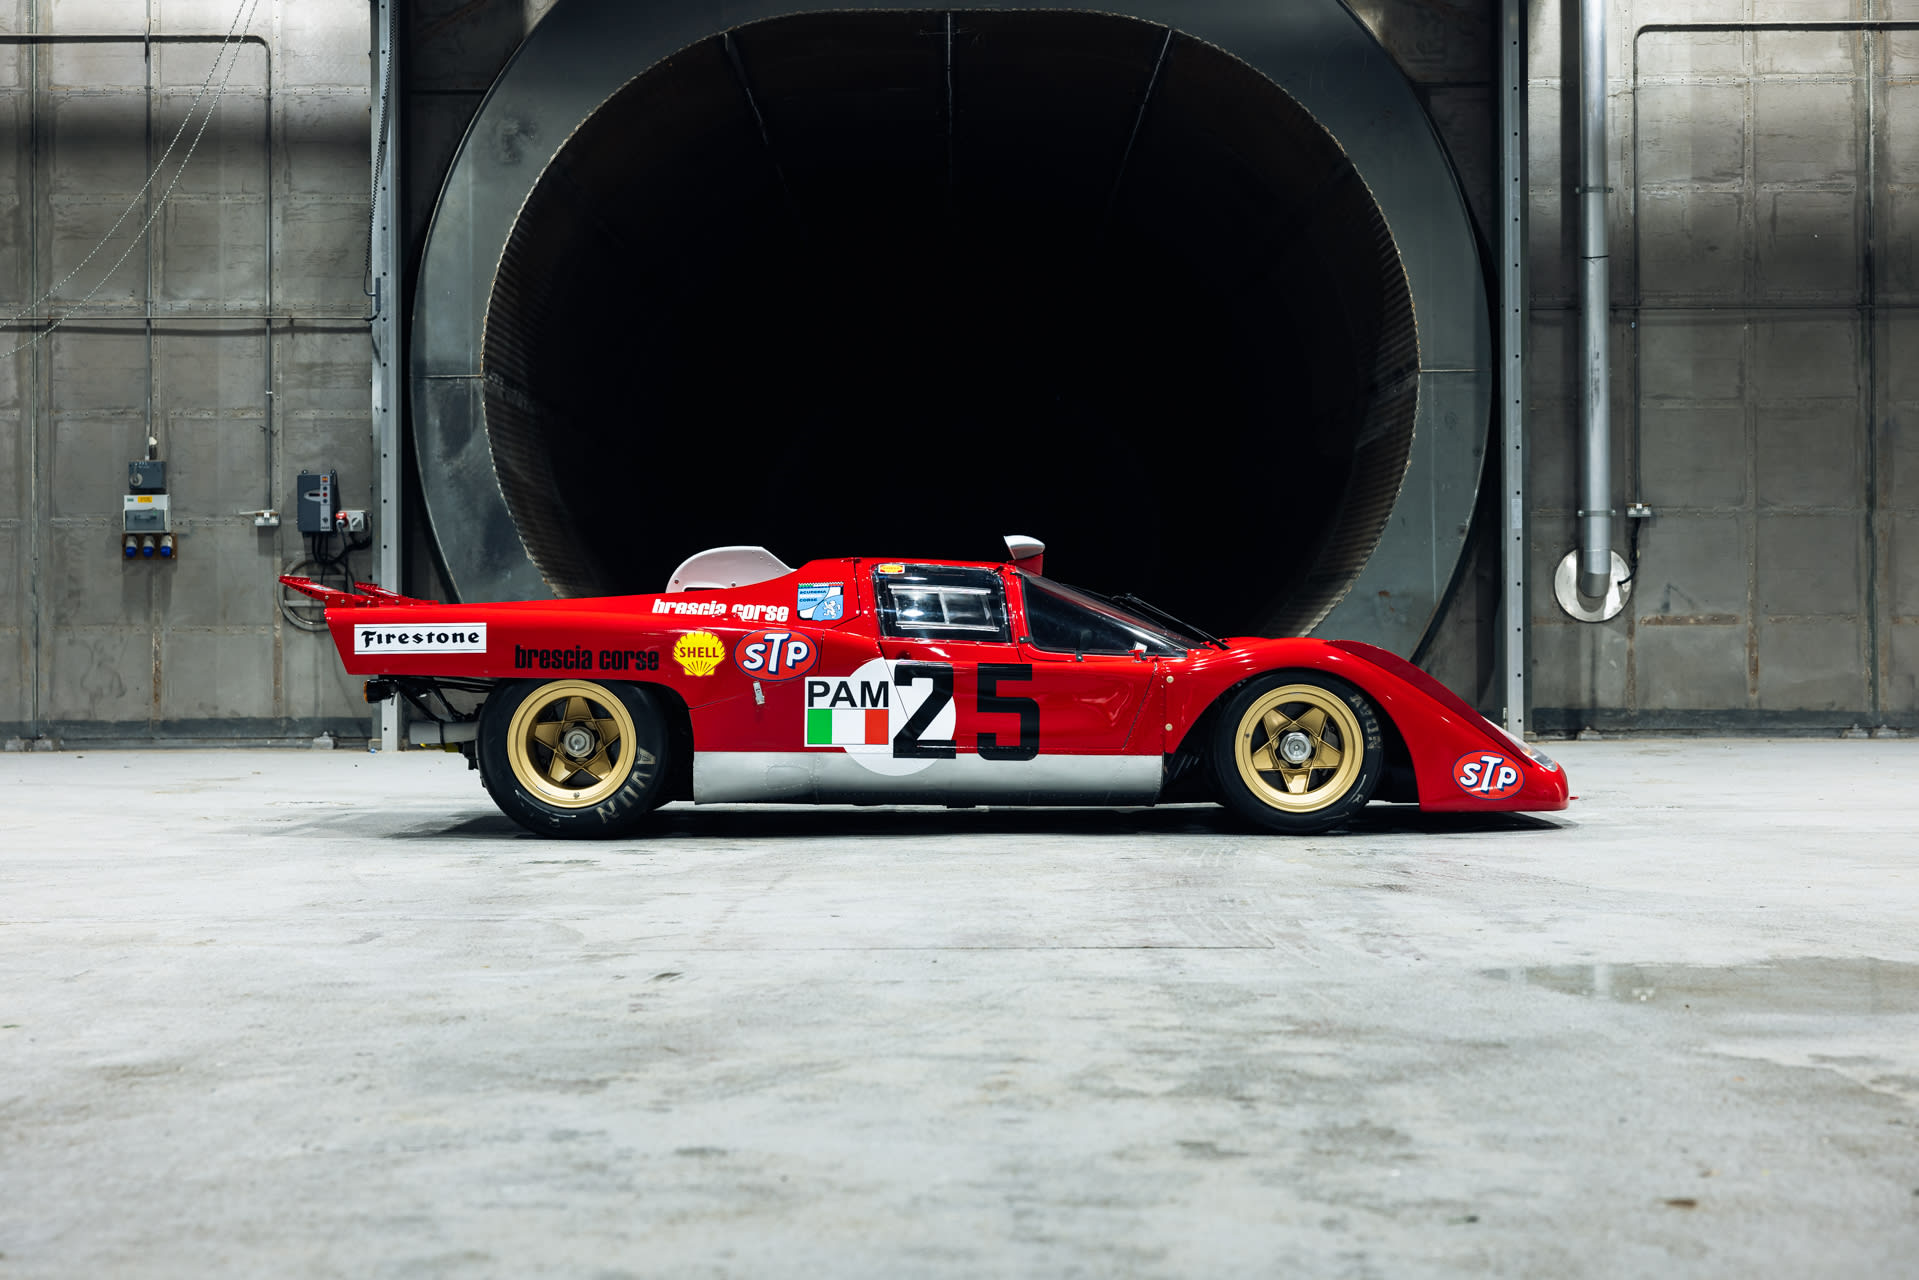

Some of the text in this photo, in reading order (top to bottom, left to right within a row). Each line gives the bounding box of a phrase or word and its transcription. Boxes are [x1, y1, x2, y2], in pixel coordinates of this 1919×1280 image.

[731, 603, 790, 622] corse
[361, 631, 480, 648] Firestone
[680, 647, 719, 658] SHELL
[515, 644, 660, 671] brescia corse
[743, 633, 810, 675] STP
[807, 680, 889, 708] PAM
[893, 662, 1040, 761] 25
[596, 746, 657, 824] AVON
[1460, 755, 1518, 794] STP
